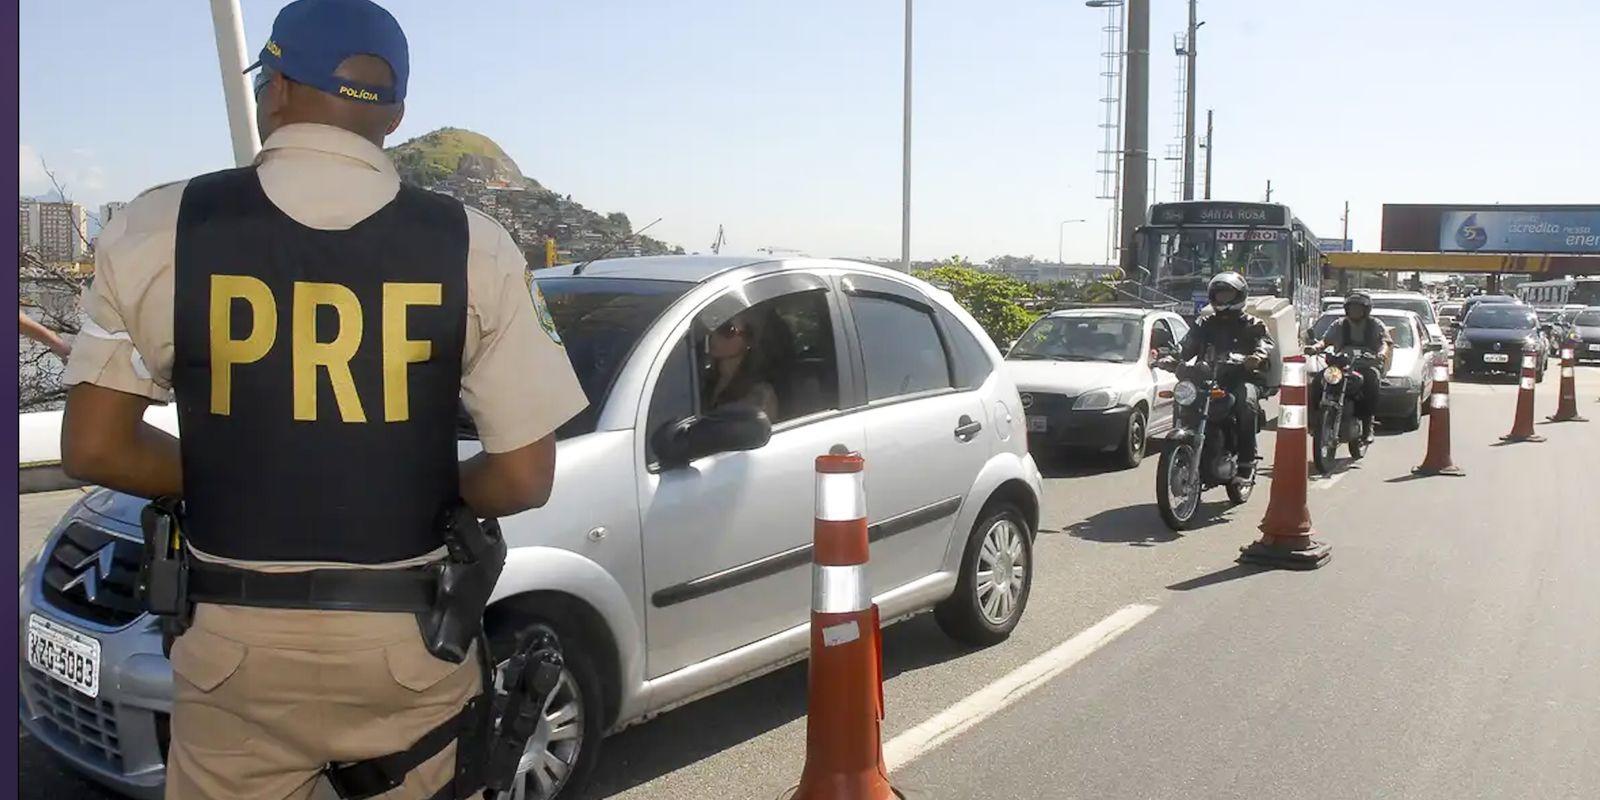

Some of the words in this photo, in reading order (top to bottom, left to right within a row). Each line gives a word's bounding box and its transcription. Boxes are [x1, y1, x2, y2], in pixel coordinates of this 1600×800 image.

[339, 85, 378, 101] POLÍCIA
[1200, 209, 1233, 220] SANTA
[1238, 209, 1266, 220] ROSA
[1508, 222, 1560, 233] acredita
[210, 274, 442, 423] PRF
